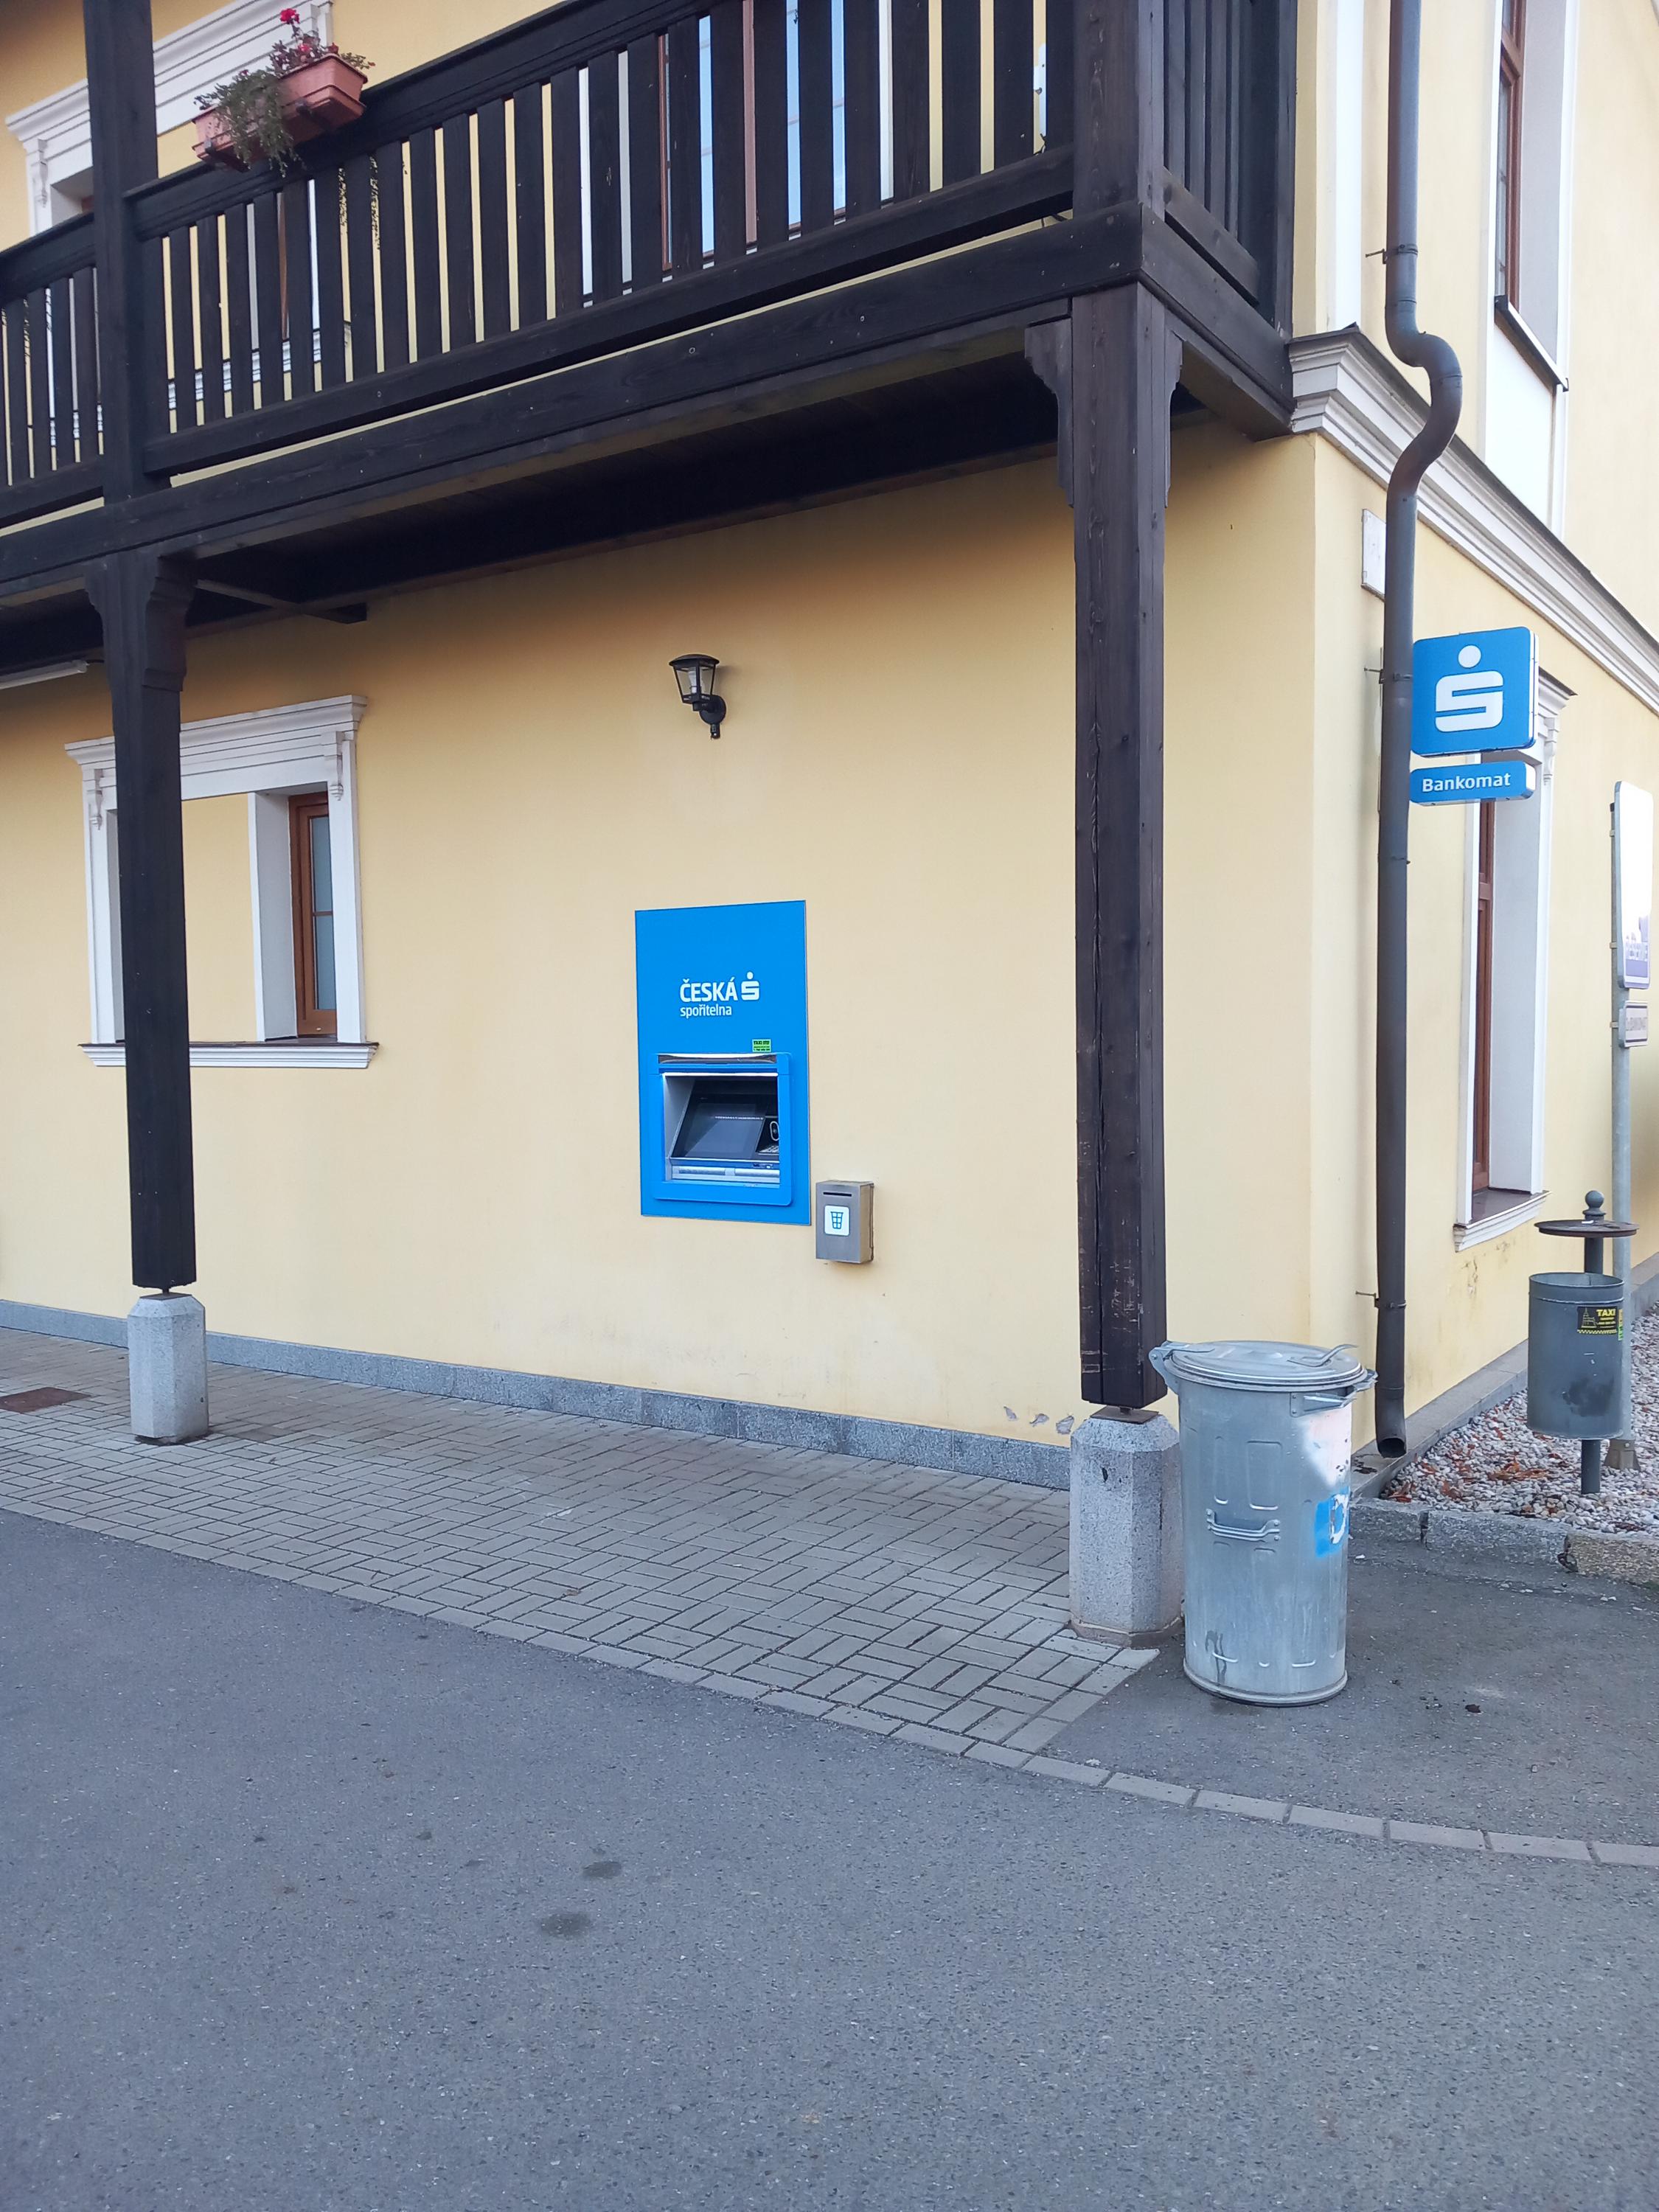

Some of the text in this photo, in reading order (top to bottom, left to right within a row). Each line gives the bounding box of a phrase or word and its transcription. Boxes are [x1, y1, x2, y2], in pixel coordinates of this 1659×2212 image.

[1422, 773, 1512, 793] Bankomat
[680, 976, 738, 1003] ČESKÁ
[680, 1003, 732, 1019] spořitelna
[1596, 1309, 1616, 1317] TAXI
